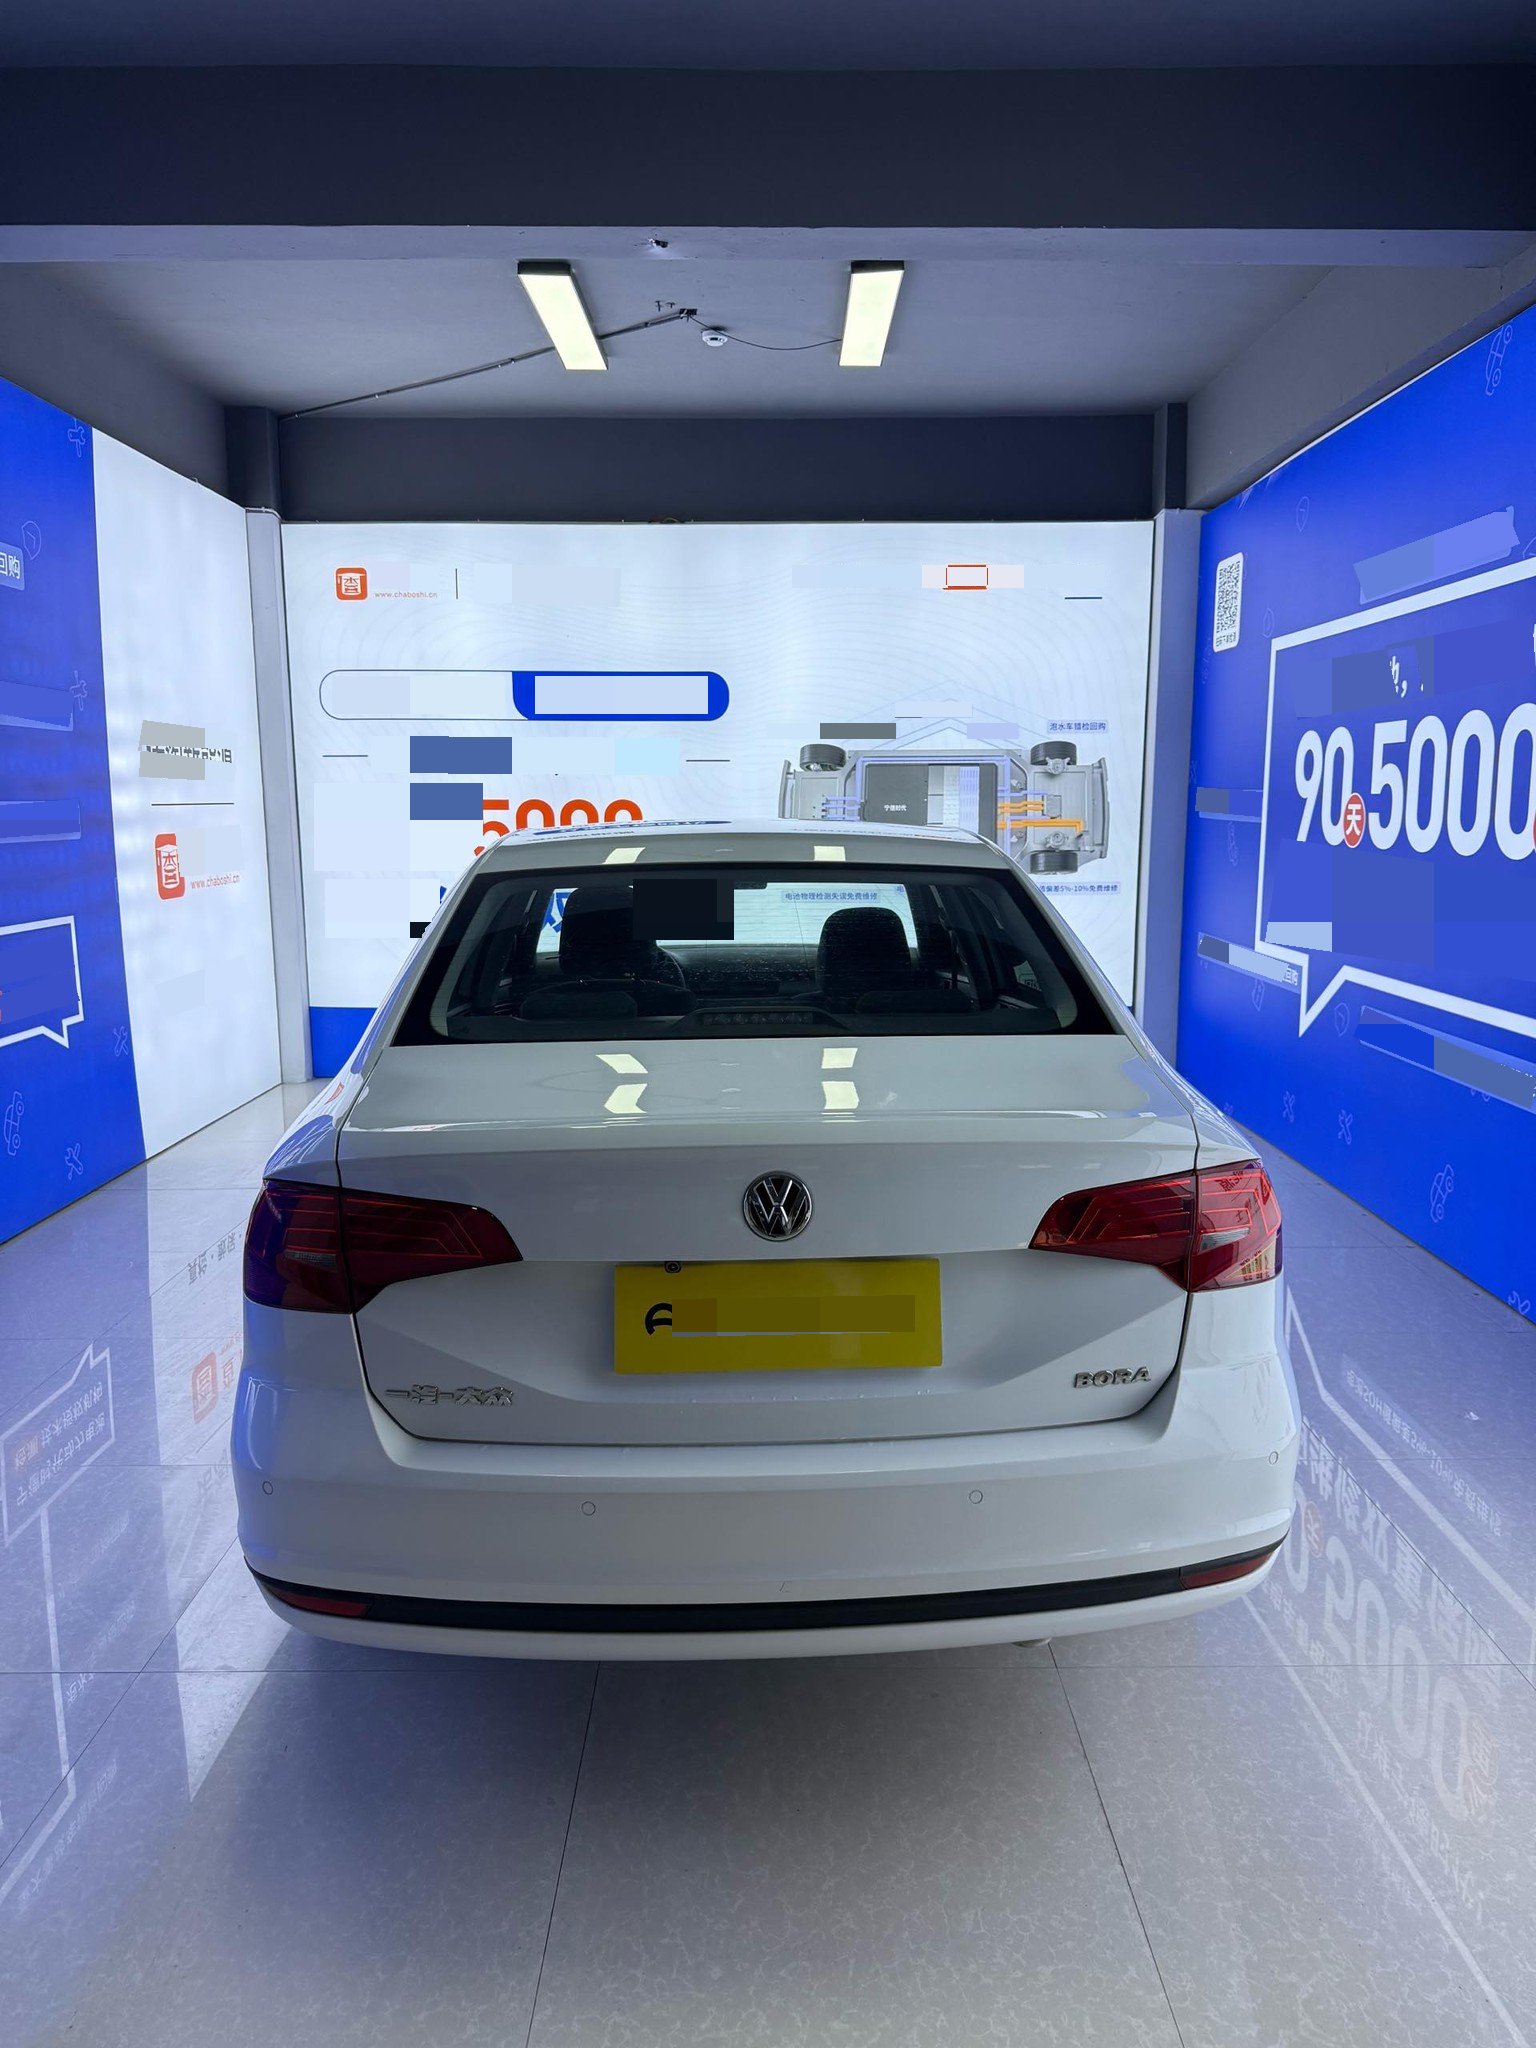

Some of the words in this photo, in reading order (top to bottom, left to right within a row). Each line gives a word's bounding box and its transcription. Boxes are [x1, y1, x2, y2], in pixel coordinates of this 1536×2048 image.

[374, 591, 438, 599] www.chaboshi.cn
[190, 873, 240, 890] www.chaboshi.cn
[1073, 1366, 1151, 1388] BORA
